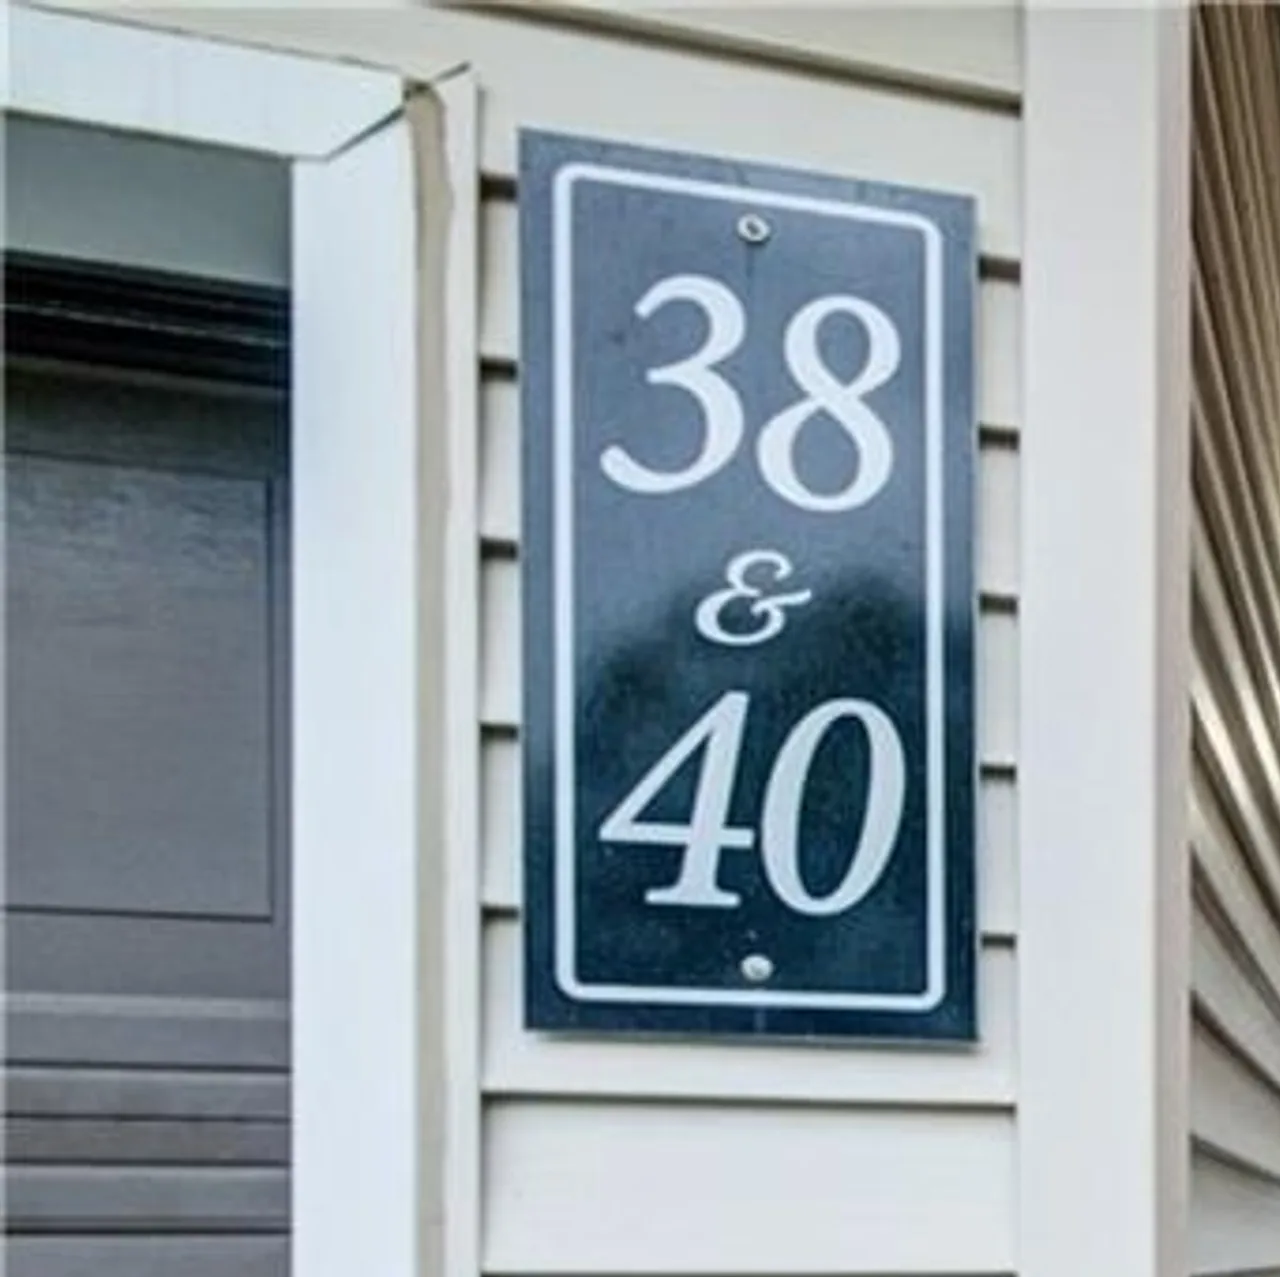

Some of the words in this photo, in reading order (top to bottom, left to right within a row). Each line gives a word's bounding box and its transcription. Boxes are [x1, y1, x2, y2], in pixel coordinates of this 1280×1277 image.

[600, 275, 901, 511] 38
[696, 549, 812, 646] &
[600, 690, 907, 915] 40
